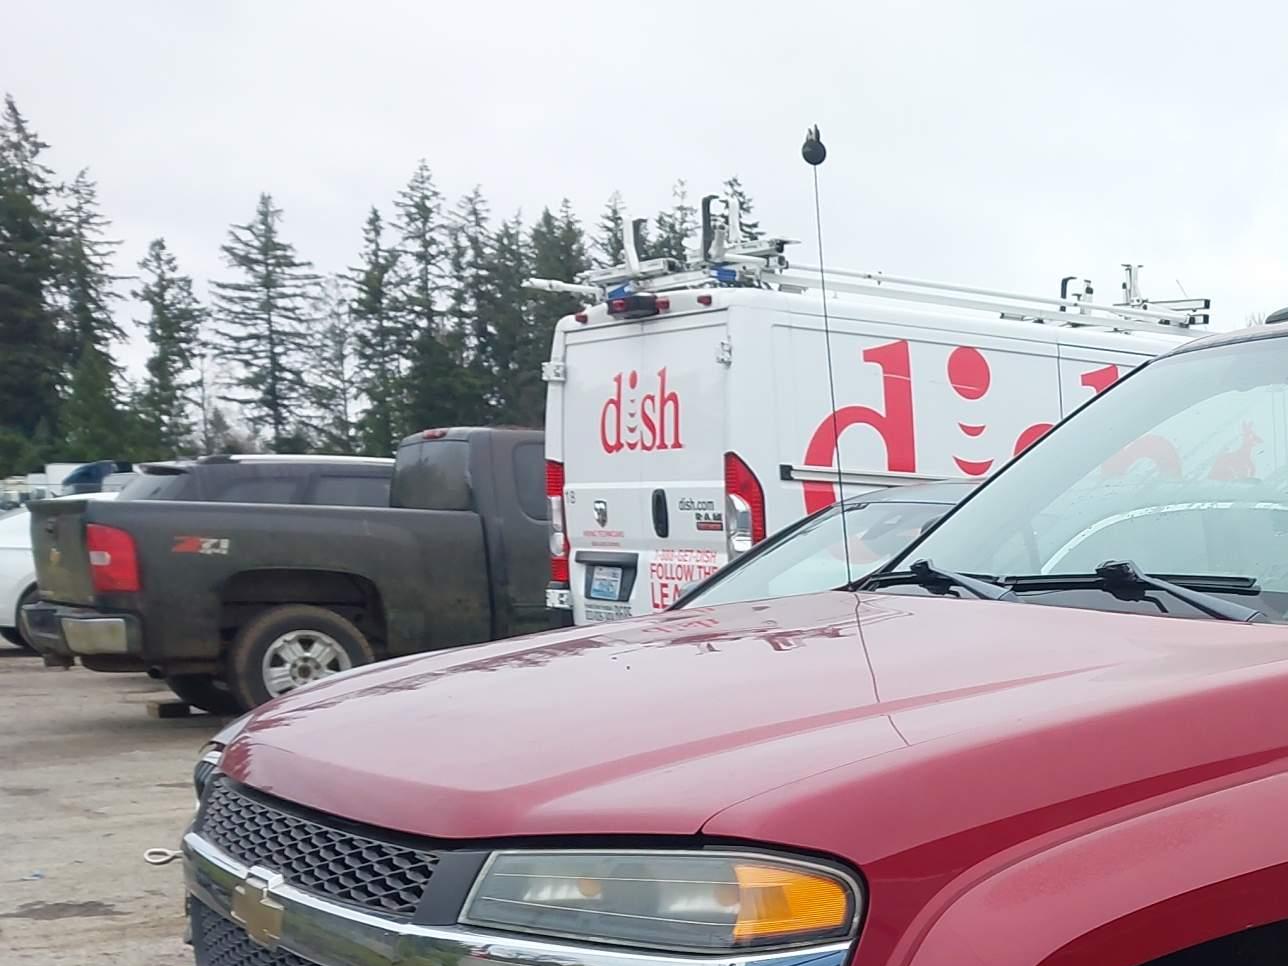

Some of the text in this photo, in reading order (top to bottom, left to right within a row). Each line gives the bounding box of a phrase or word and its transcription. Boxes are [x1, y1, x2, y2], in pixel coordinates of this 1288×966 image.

[600, 366, 683, 454] dish
[678, 497, 715, 511] dish.com
[695, 513, 723, 521] RAM
[650, 562, 694, 581] FOLLOW
